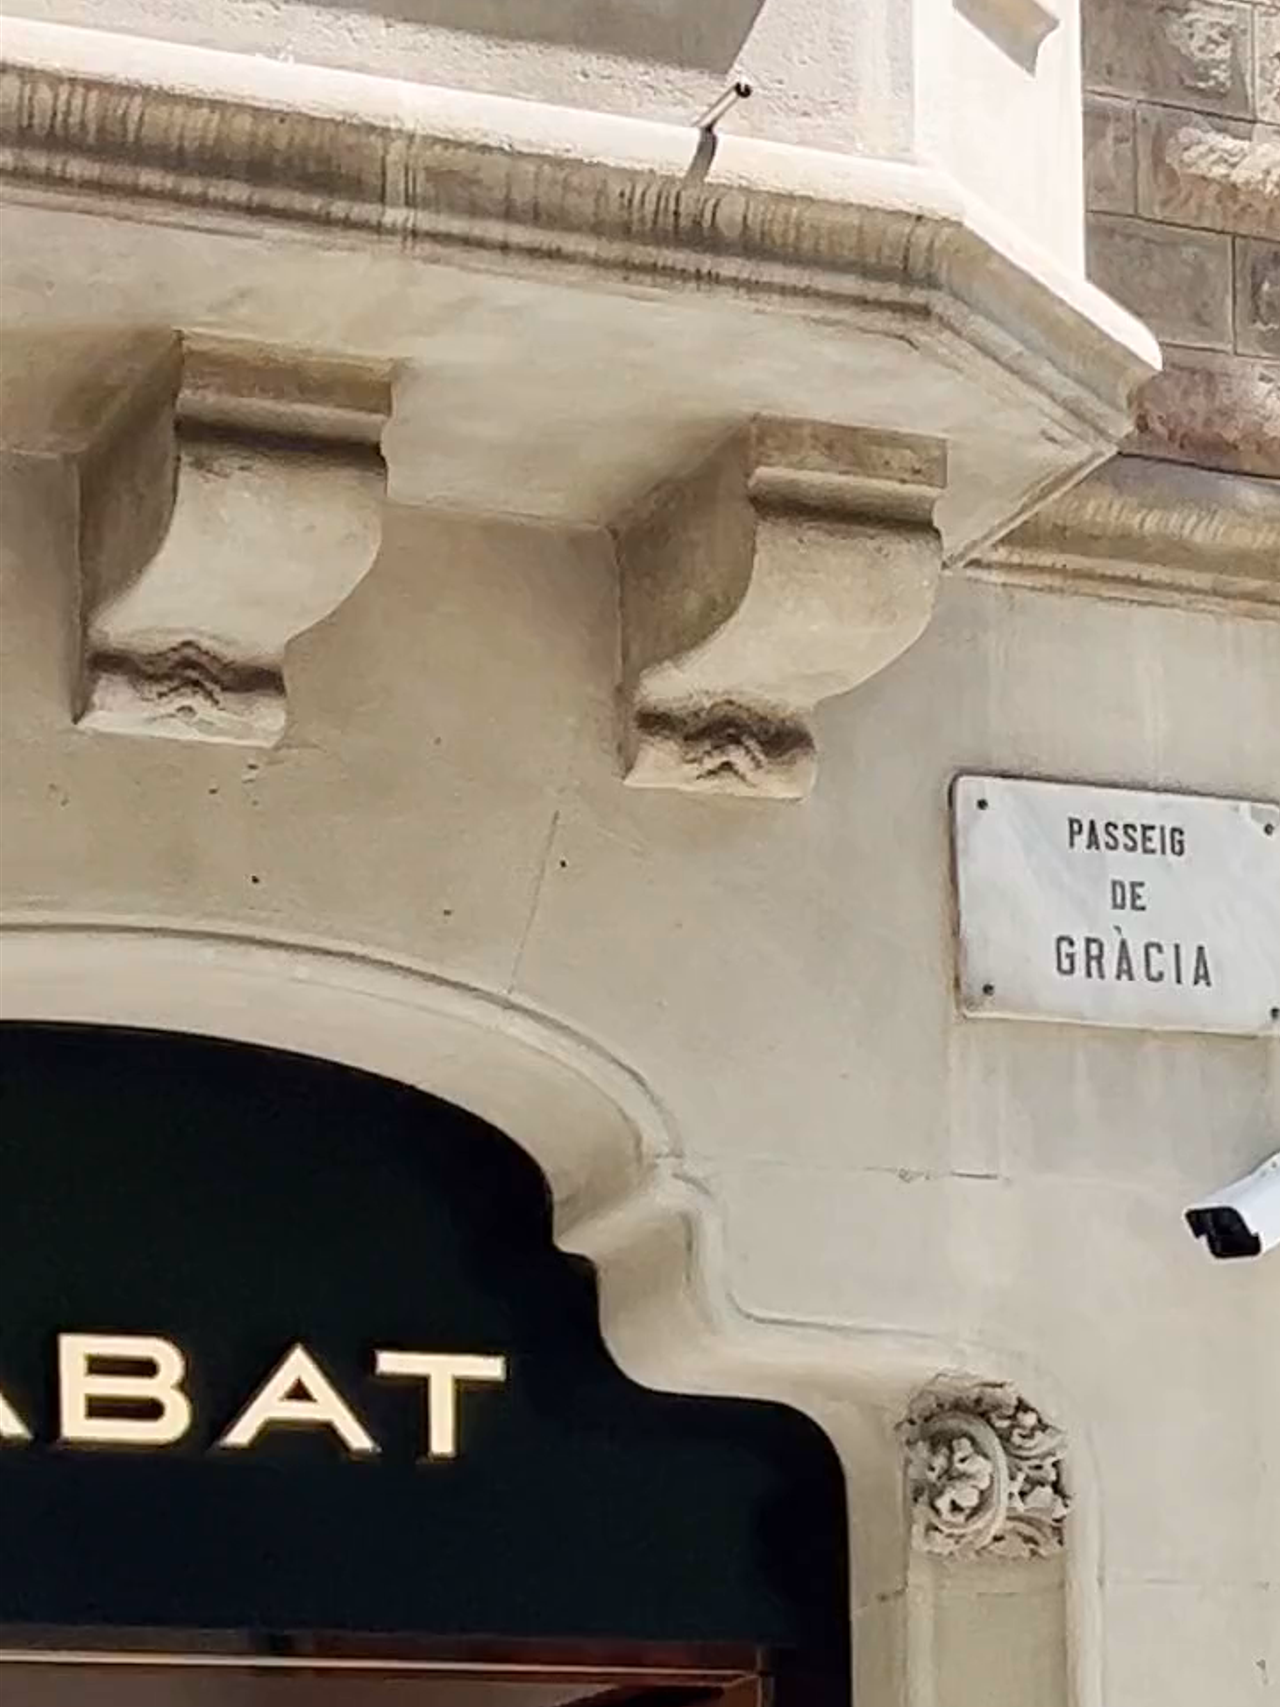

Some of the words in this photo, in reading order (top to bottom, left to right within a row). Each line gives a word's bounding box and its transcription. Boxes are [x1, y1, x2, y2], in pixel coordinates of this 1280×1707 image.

[1067, 817, 1186, 857] PASSEIG
[1111, 880, 1147, 912] DE
[1055, 925, 1213, 988] GRÀCIA
